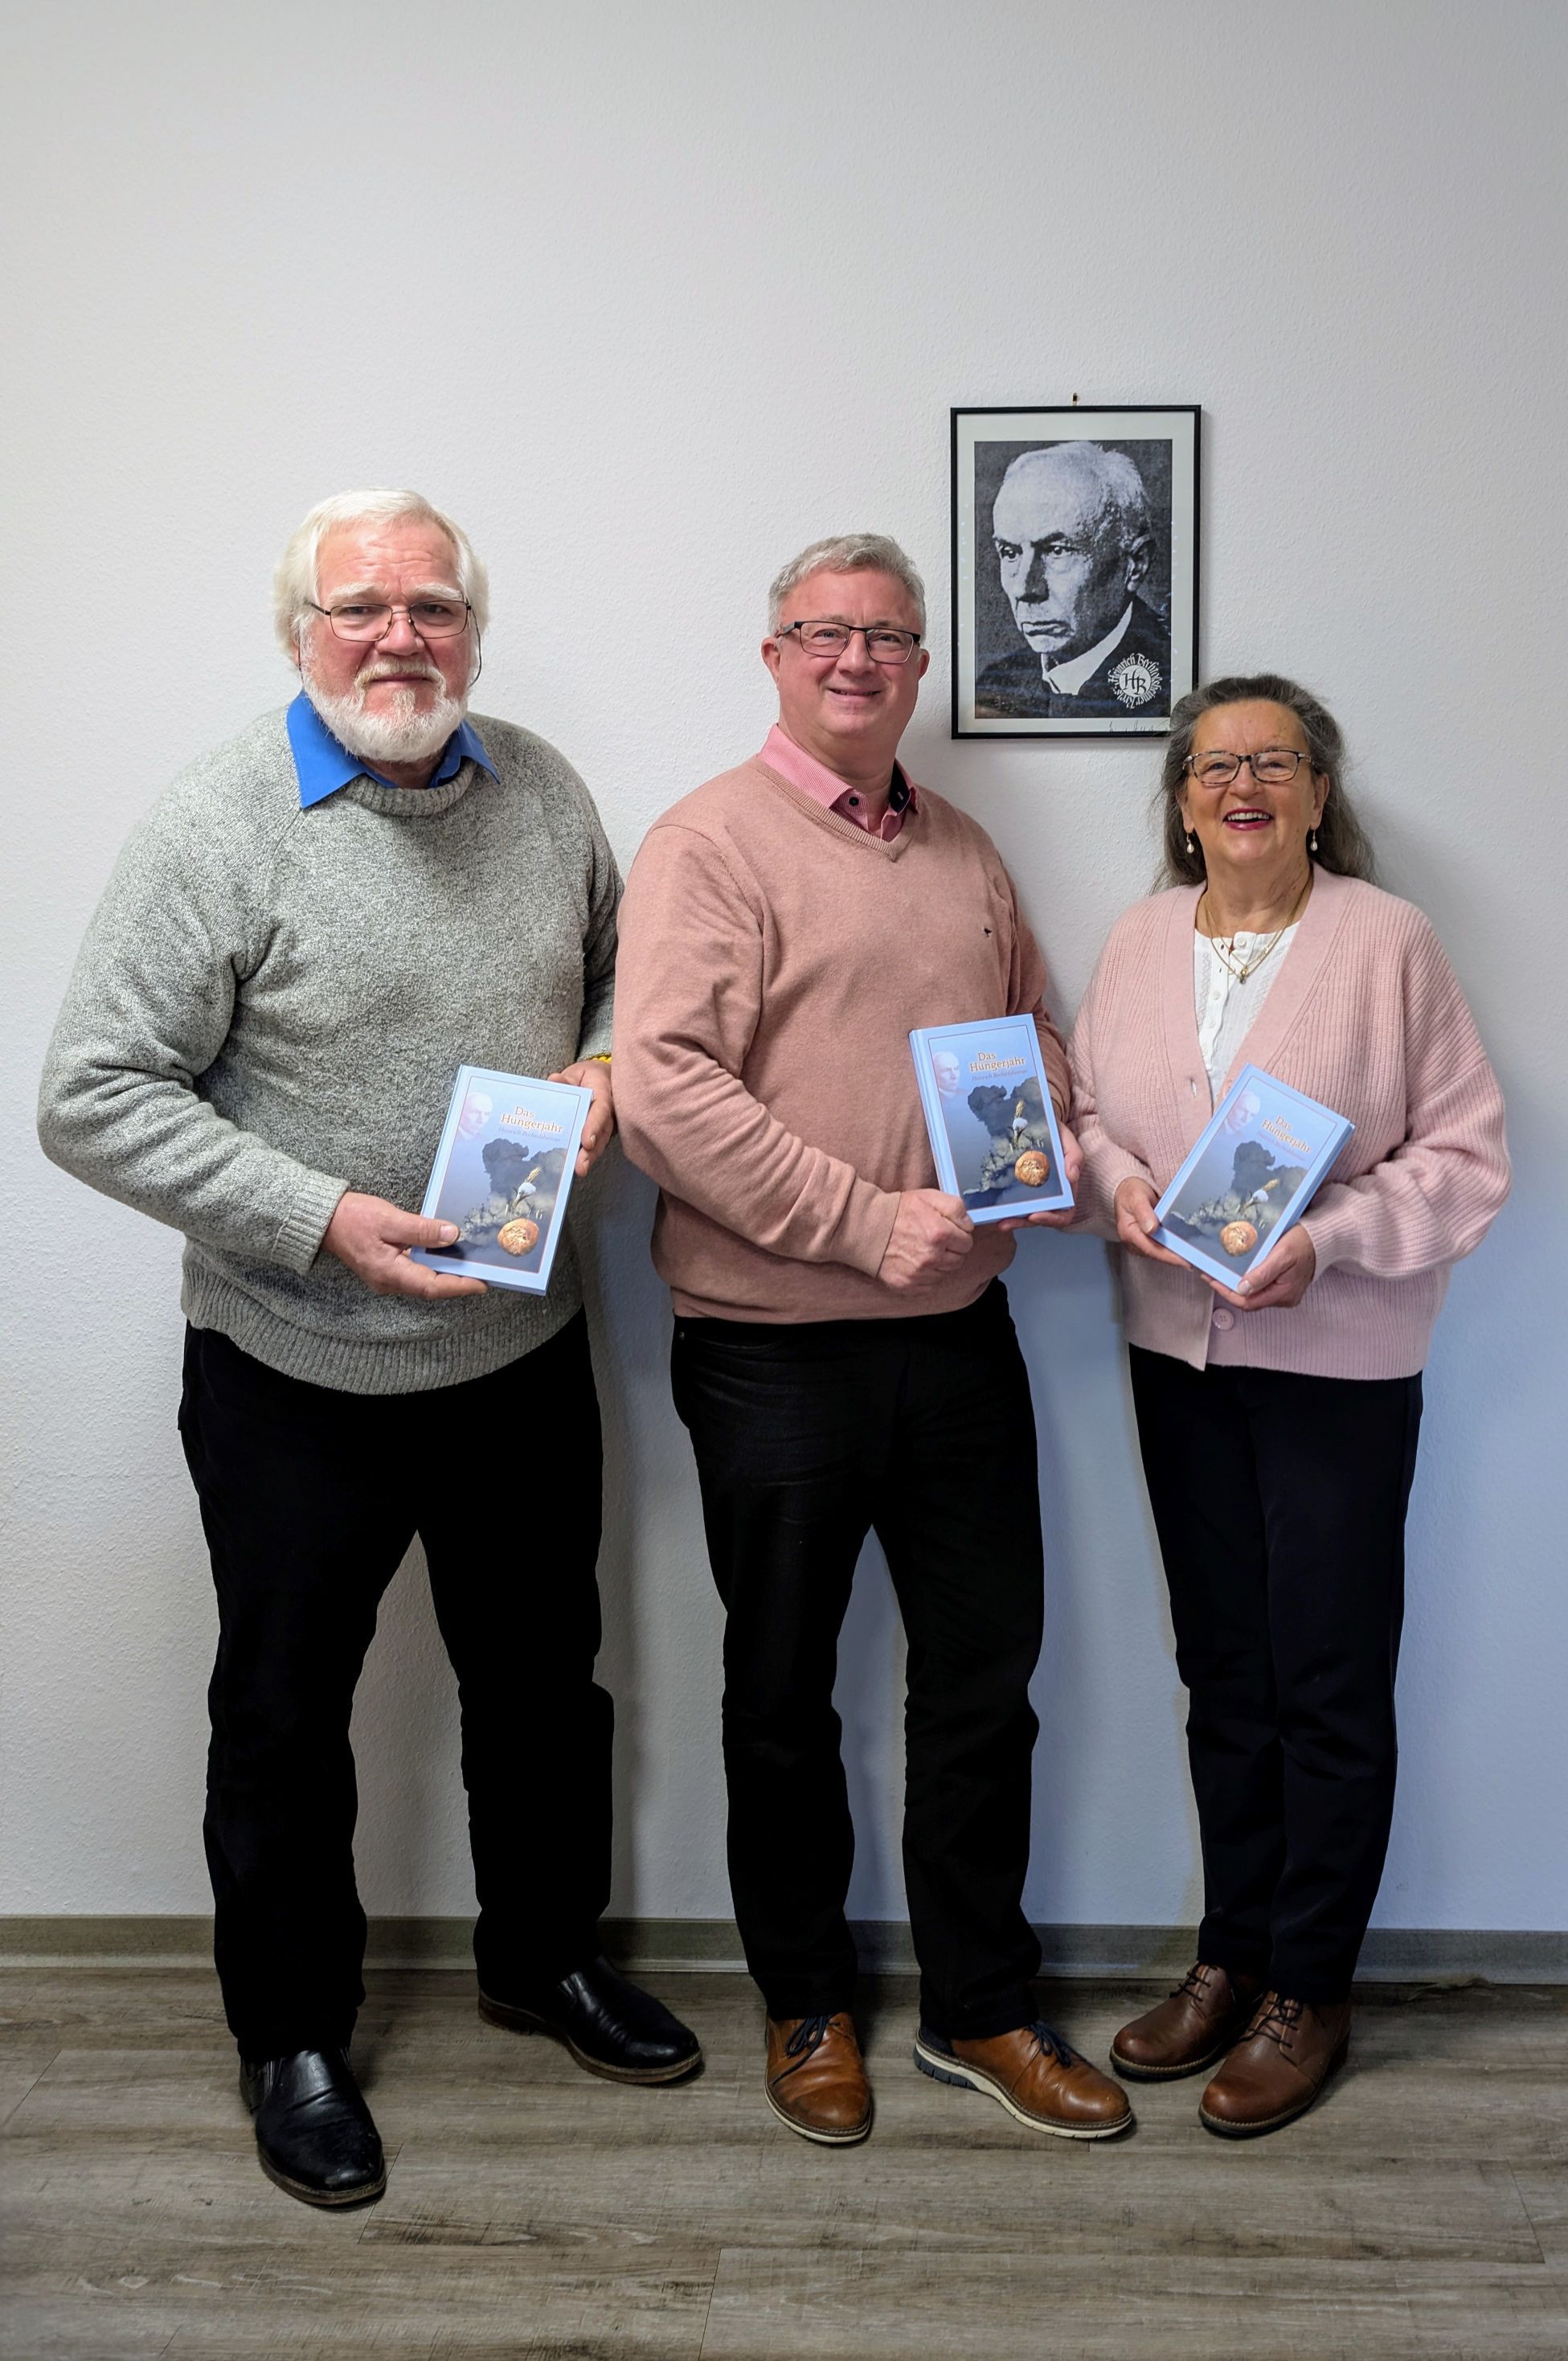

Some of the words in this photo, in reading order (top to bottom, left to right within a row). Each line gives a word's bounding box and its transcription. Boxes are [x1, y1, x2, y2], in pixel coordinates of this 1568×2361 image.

[1107, 653, 1136, 683] Heinrich
[969, 1056, 1026, 1072] Hungerjahr
[977, 1052, 996, 1061] Das
[514, 1106, 534, 1117] Das
[501, 1113, 563, 1133] Hungerjahr
[1275, 1116, 1292, 1130] Das
[1262, 1119, 1311, 1153] Hungerjahr
